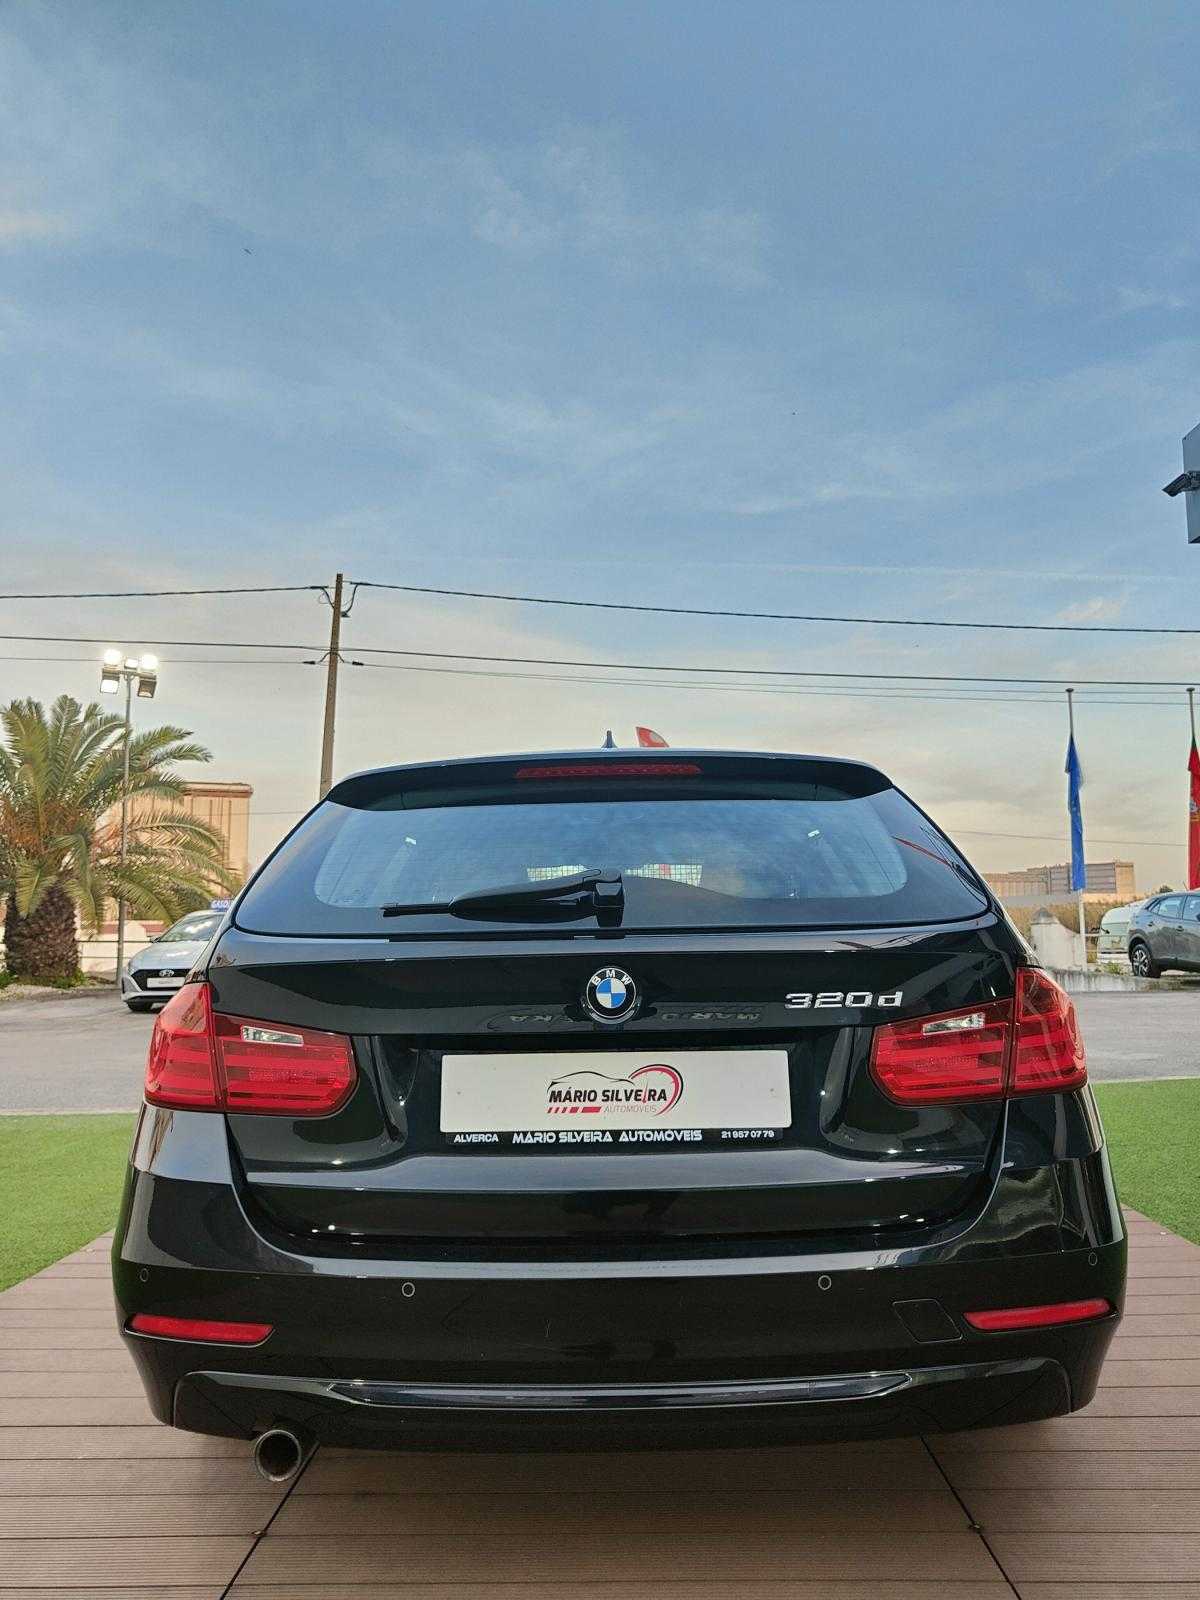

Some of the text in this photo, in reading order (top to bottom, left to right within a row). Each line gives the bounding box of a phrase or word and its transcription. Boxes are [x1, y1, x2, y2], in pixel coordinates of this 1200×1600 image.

[592, 970, 632, 985] BMW
[785, 991, 903, 1008] 320d
[549, 1085, 667, 1103] MÁRIO SILVEIRA
[453, 1133, 499, 1143] ALVERCA
[558, 1131, 614, 1142] SILVEIRA
[618, 1129, 703, 1142] AUTOMÓVEIS
